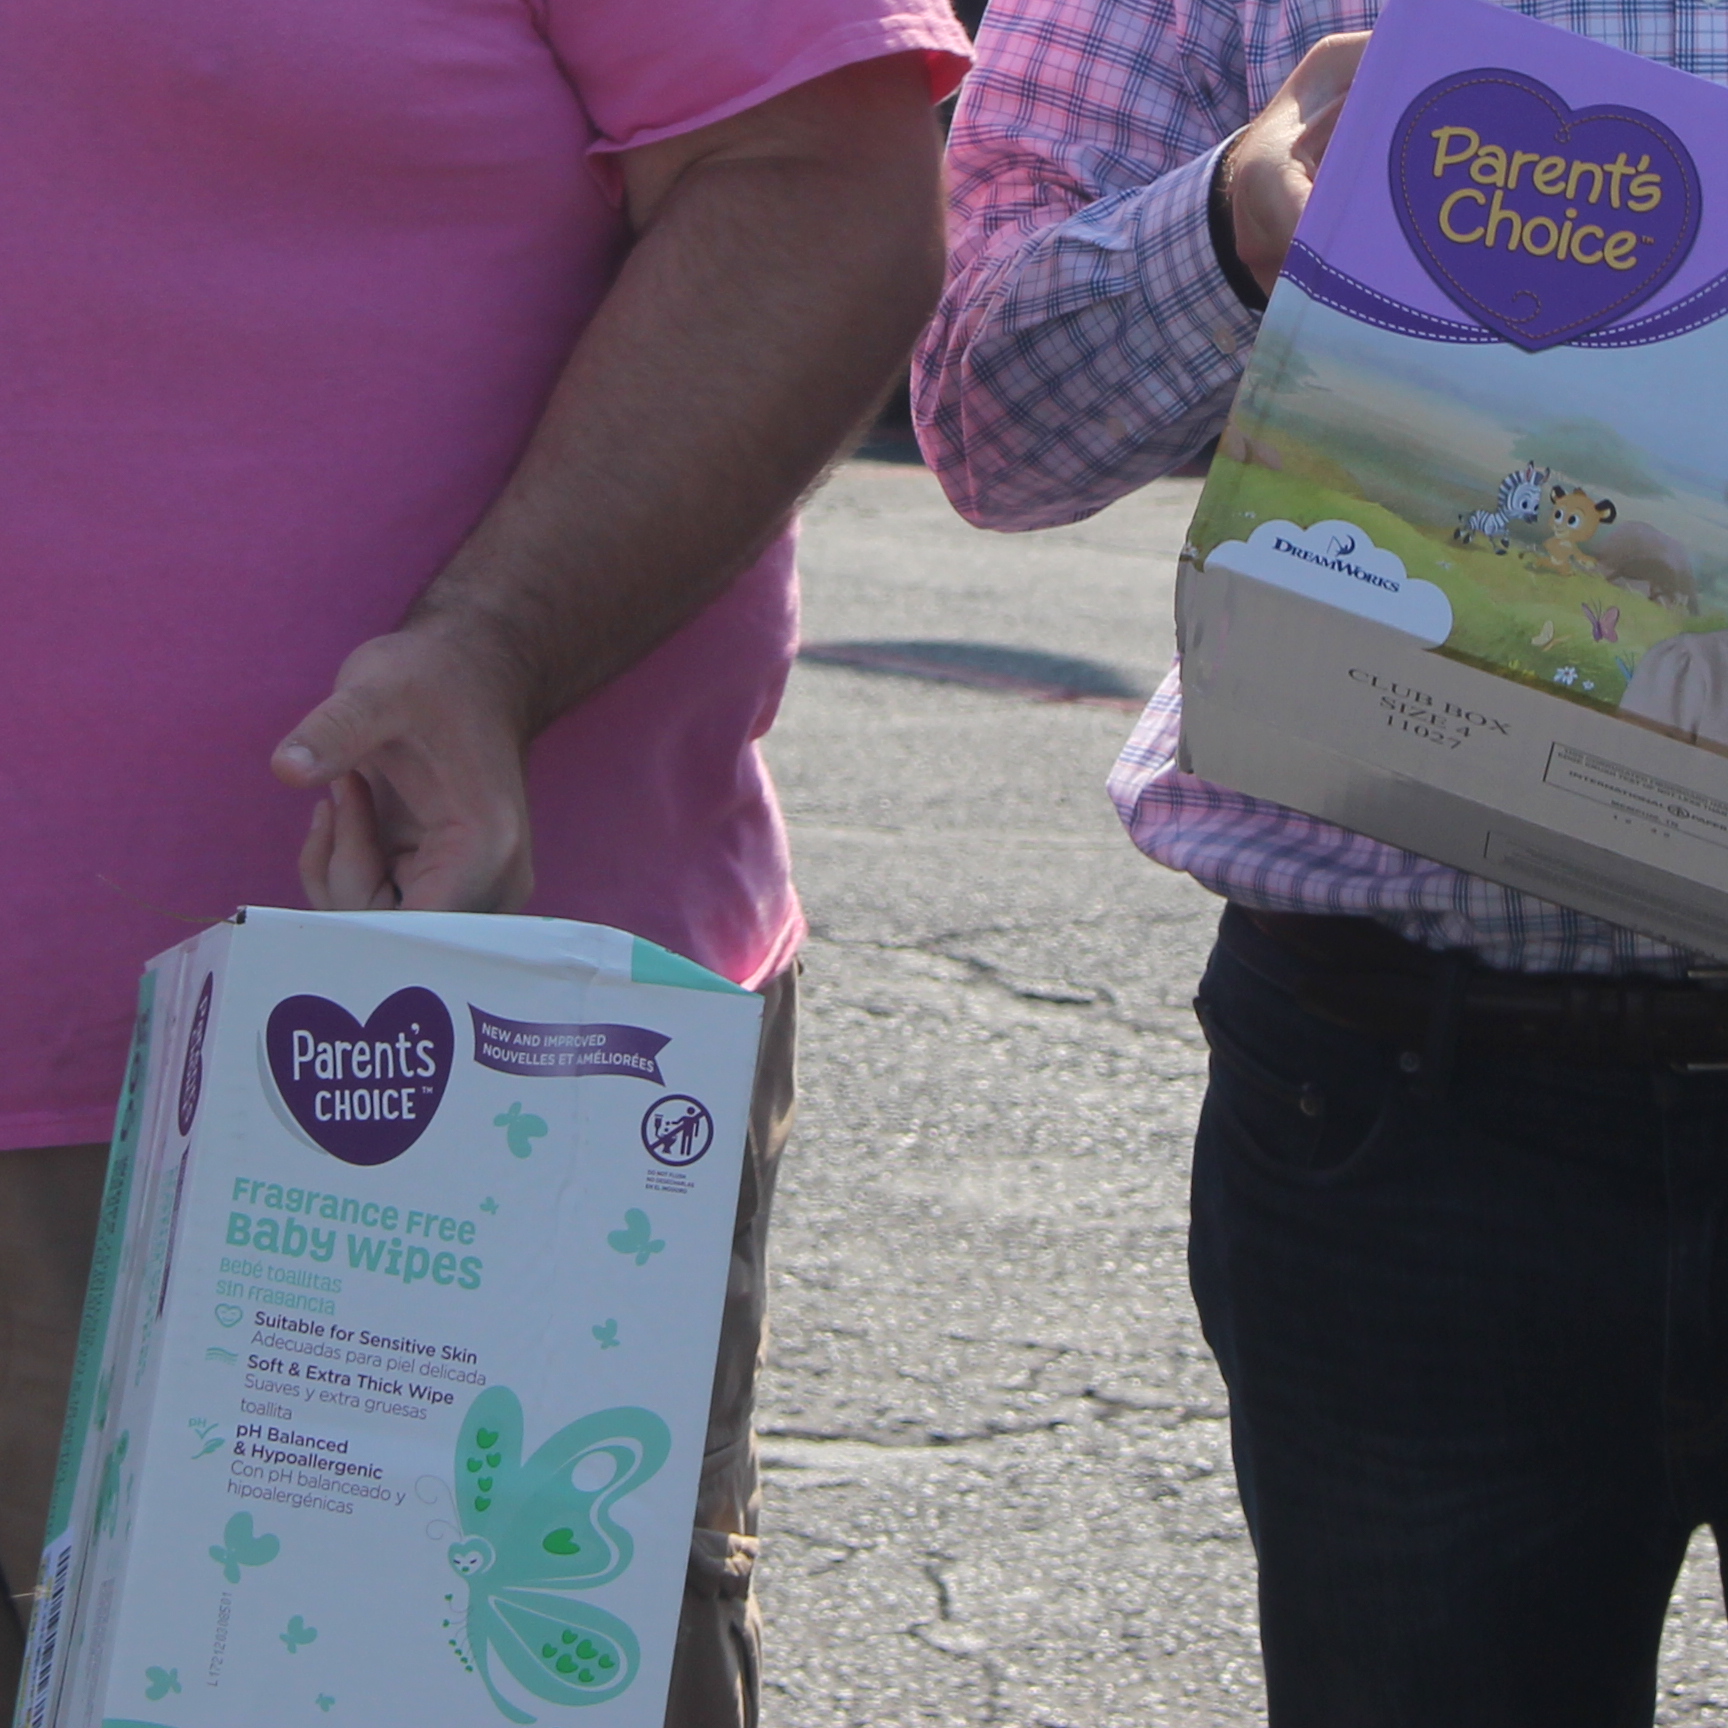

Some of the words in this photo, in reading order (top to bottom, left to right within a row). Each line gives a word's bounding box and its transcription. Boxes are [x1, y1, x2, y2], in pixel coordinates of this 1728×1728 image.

[1431, 125, 1662, 212] Parent's
[1439, 188, 1637, 270] Choice
[1348, 668, 1433, 706] CLUB
[1444, 702, 1511, 736] BOX
[1380, 696, 1447, 729] SIZE
[1456, 726, 1471, 738] 4
[1388, 715, 1461, 749] 11027
[293, 1022, 436, 1080] Parent's
[481, 1022, 511, 1043] NEW
[513, 1034, 541, 1047] AND
[544, 1034, 606, 1048] IMPROVED
[483, 1042, 555, 1066] NOUVELLES
[558, 1053, 573, 1066] ET
[576, 1049, 655, 1073] AMÉLIORÉES
[315, 1088, 416, 1121] CHOICE
[232, 1176, 399, 1232] Fragrance
[405, 1210, 476, 1245] Free
[225, 1211, 337, 1263] Baby
[216, 1279, 243, 1298] sin
[219, 1257, 263, 1278] Bebé
[268, 1264, 342, 1294] toallitas
[251, 1330, 341, 1359] Adecuadas
[346, 1349, 382, 1368] para
[386, 1355, 415, 1374] piel
[419, 1361, 487, 1386] delicada
[254, 1311, 325, 1337] Suitable
[330, 1325, 355, 1342] for
[359, 1331, 436, 1357] Sensitive
[441, 1345, 478, 1365] Skin
[244, 1374, 300, 1397] Suaves
[306, 1388, 315, 1402] y
[319, 1389, 360, 1408] extra
[364, 1399, 427, 1420] gruesas
[247, 1354, 283, 1375] Soft
[288, 1363, 300, 1377] &
[306, 1365, 351, 1386] Extra
[357, 1374, 402, 1396] Thick
[408, 1383, 454, 1406] Wipe
[240, 1397, 292, 1420] toallita
[233, 1441, 245, 1456] &
[251, 1444, 383, 1480] Hypoallergenic
[236, 1423, 262, 1439] pH
[267, 1427, 349, 1454] Balanced
[227, 1479, 354, 1515] hipoalergénicas
[230, 1460, 264, 1478] Con
[268, 1469, 293, 1485] pH
[297, 1472, 391, 1502] balanceado
[395, 1491, 406, 1506] y
